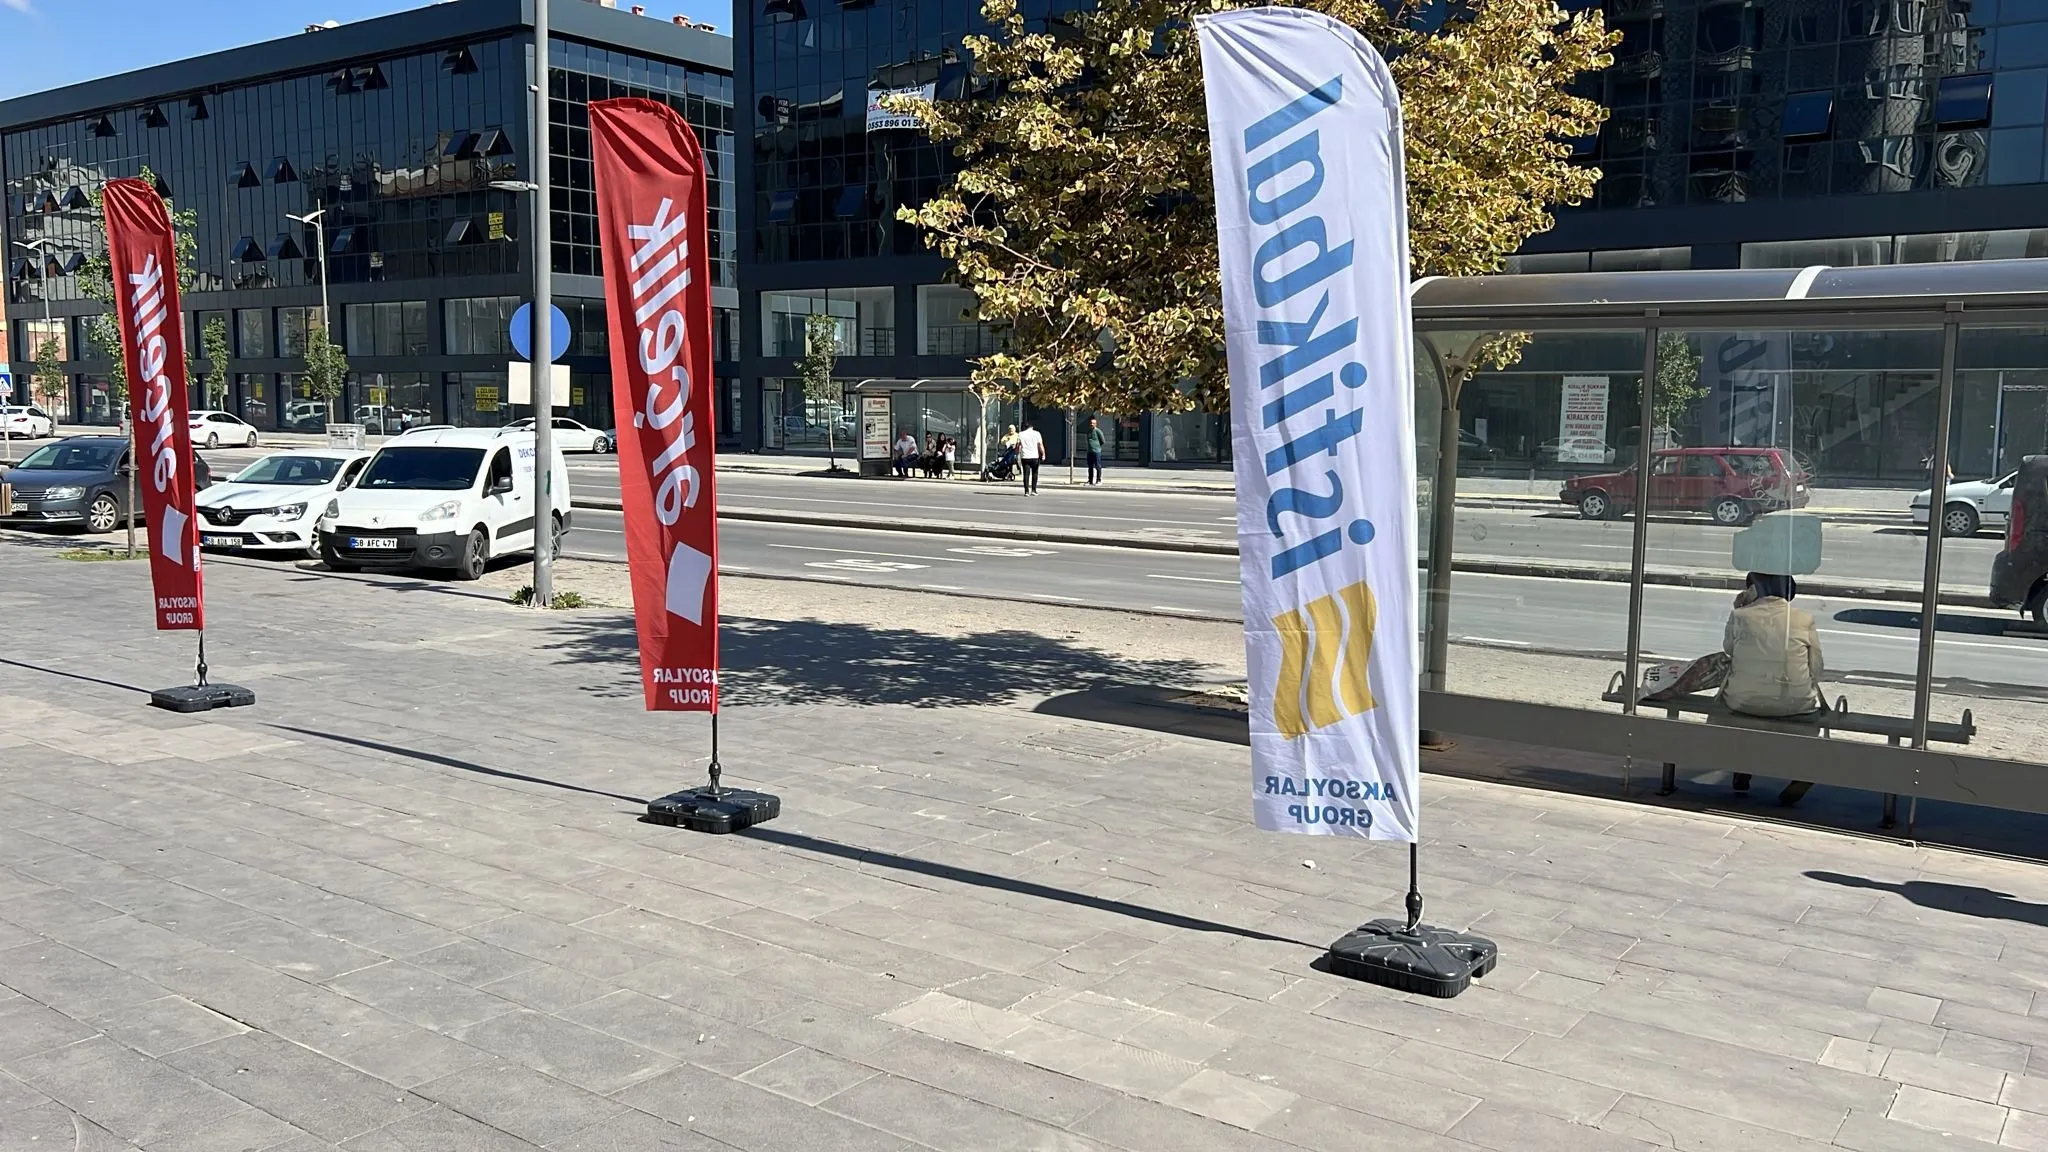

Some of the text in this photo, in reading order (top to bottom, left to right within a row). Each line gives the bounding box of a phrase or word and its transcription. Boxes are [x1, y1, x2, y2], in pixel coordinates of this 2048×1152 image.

[867, 121, 883, 130] 0553
[884, 119, 899, 127] 896
[901, 119, 911, 127] 01
[517, 447, 536, 458] DEKO
[355, 539, 395, 548] 58 AFC 471
